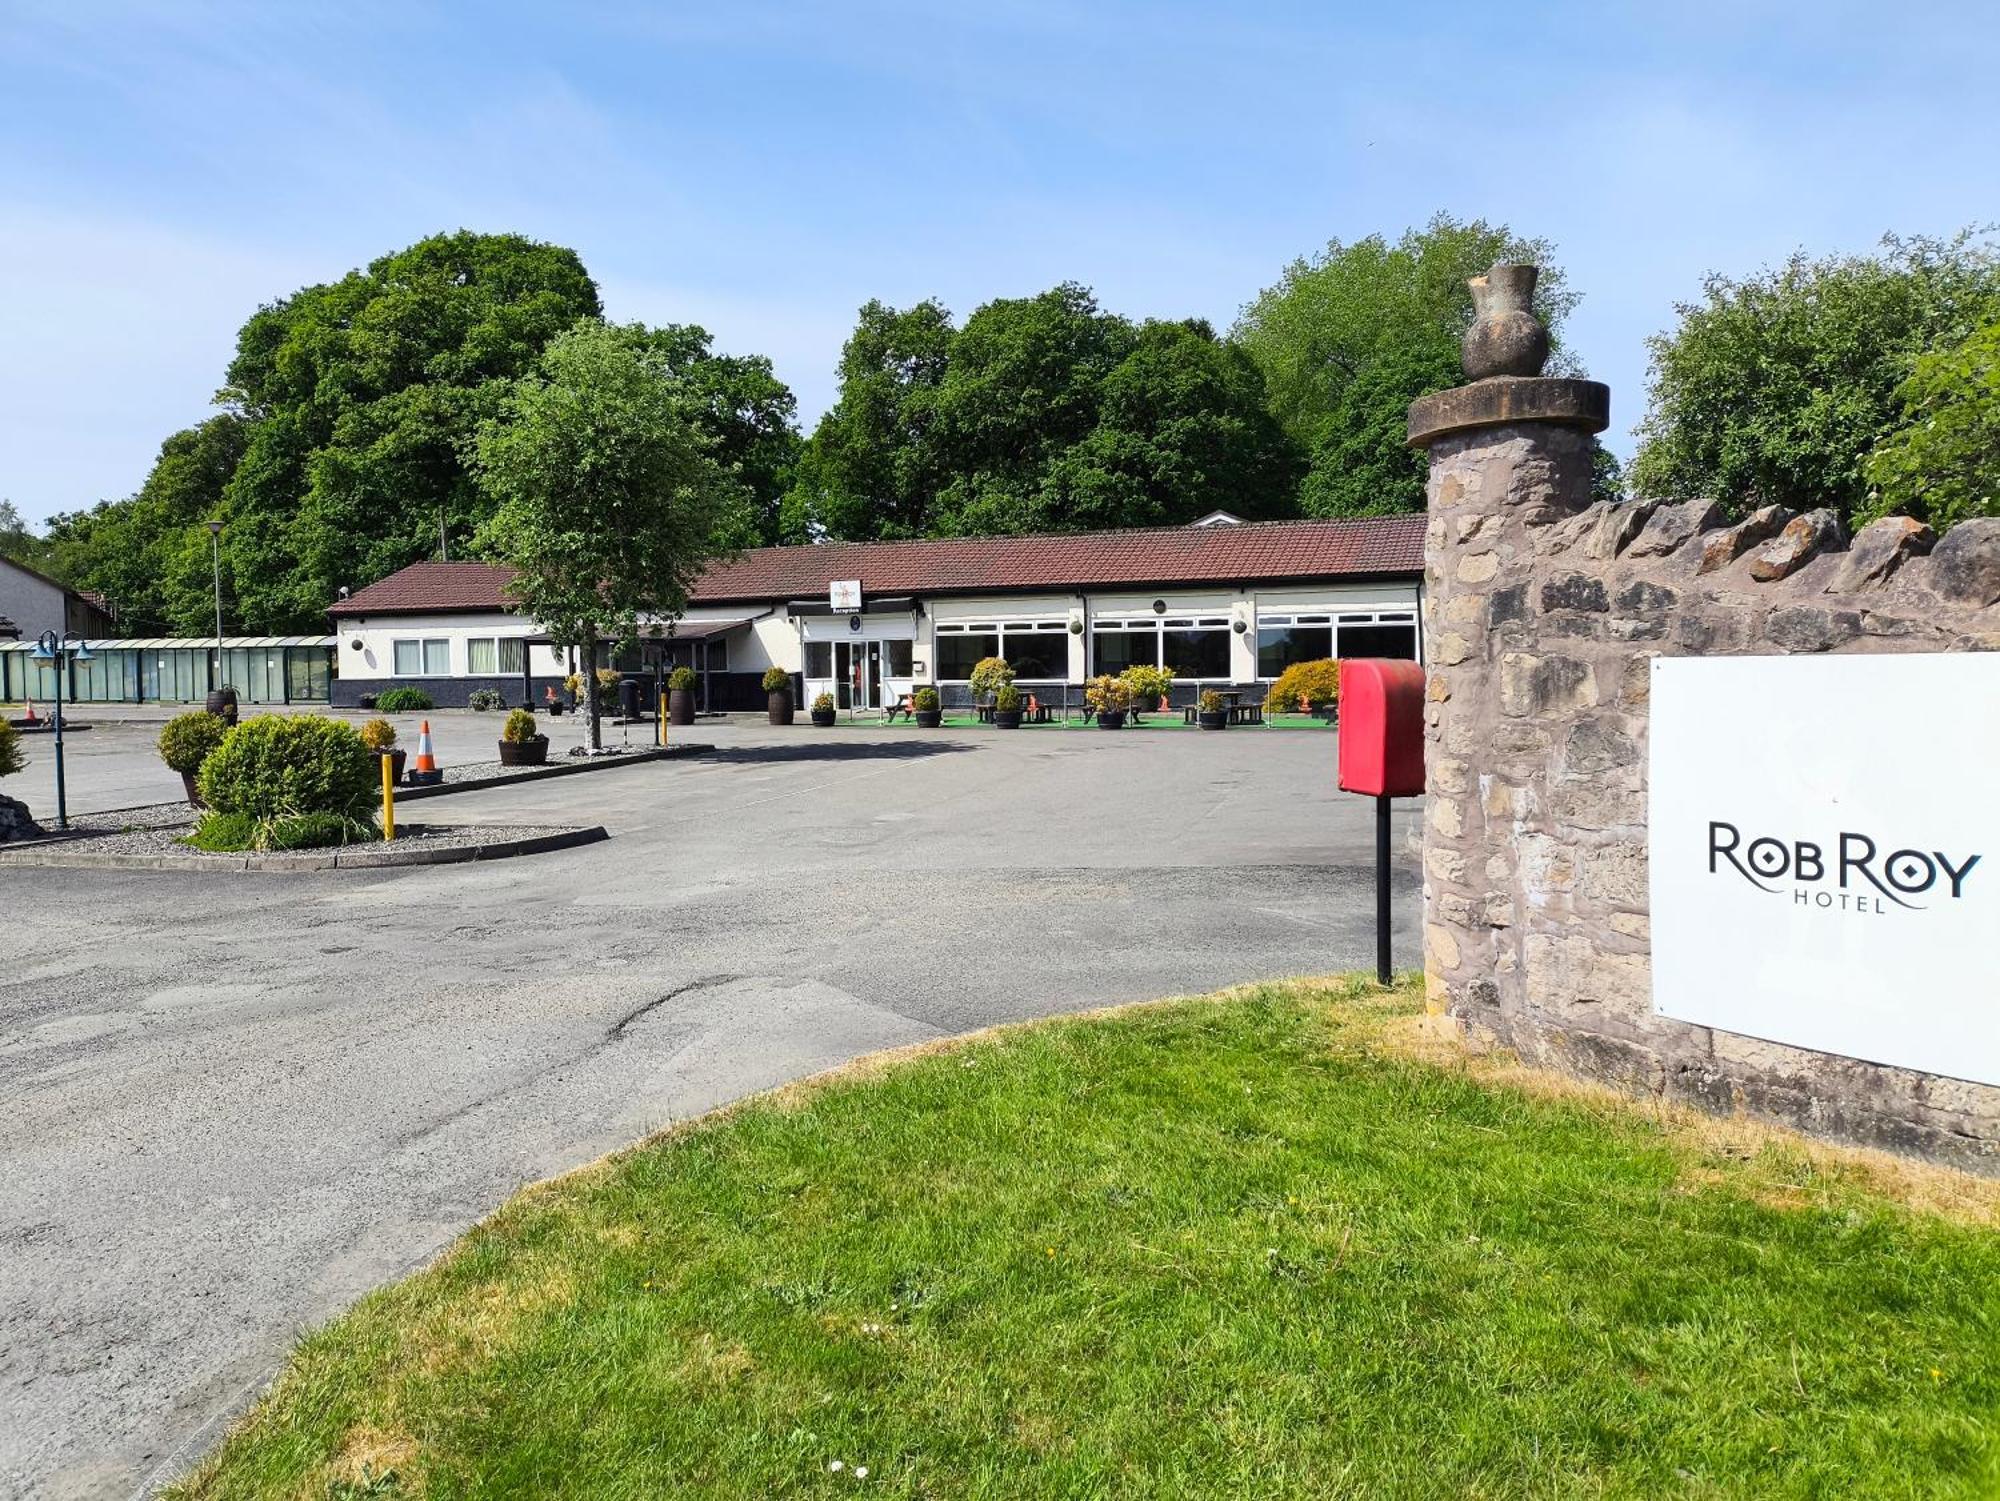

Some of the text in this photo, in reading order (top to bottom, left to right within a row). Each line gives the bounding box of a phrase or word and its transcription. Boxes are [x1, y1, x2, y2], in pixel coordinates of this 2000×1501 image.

[1709, 821, 1982, 910] ROB ROY
[1794, 888, 1886, 914] HOTEL
